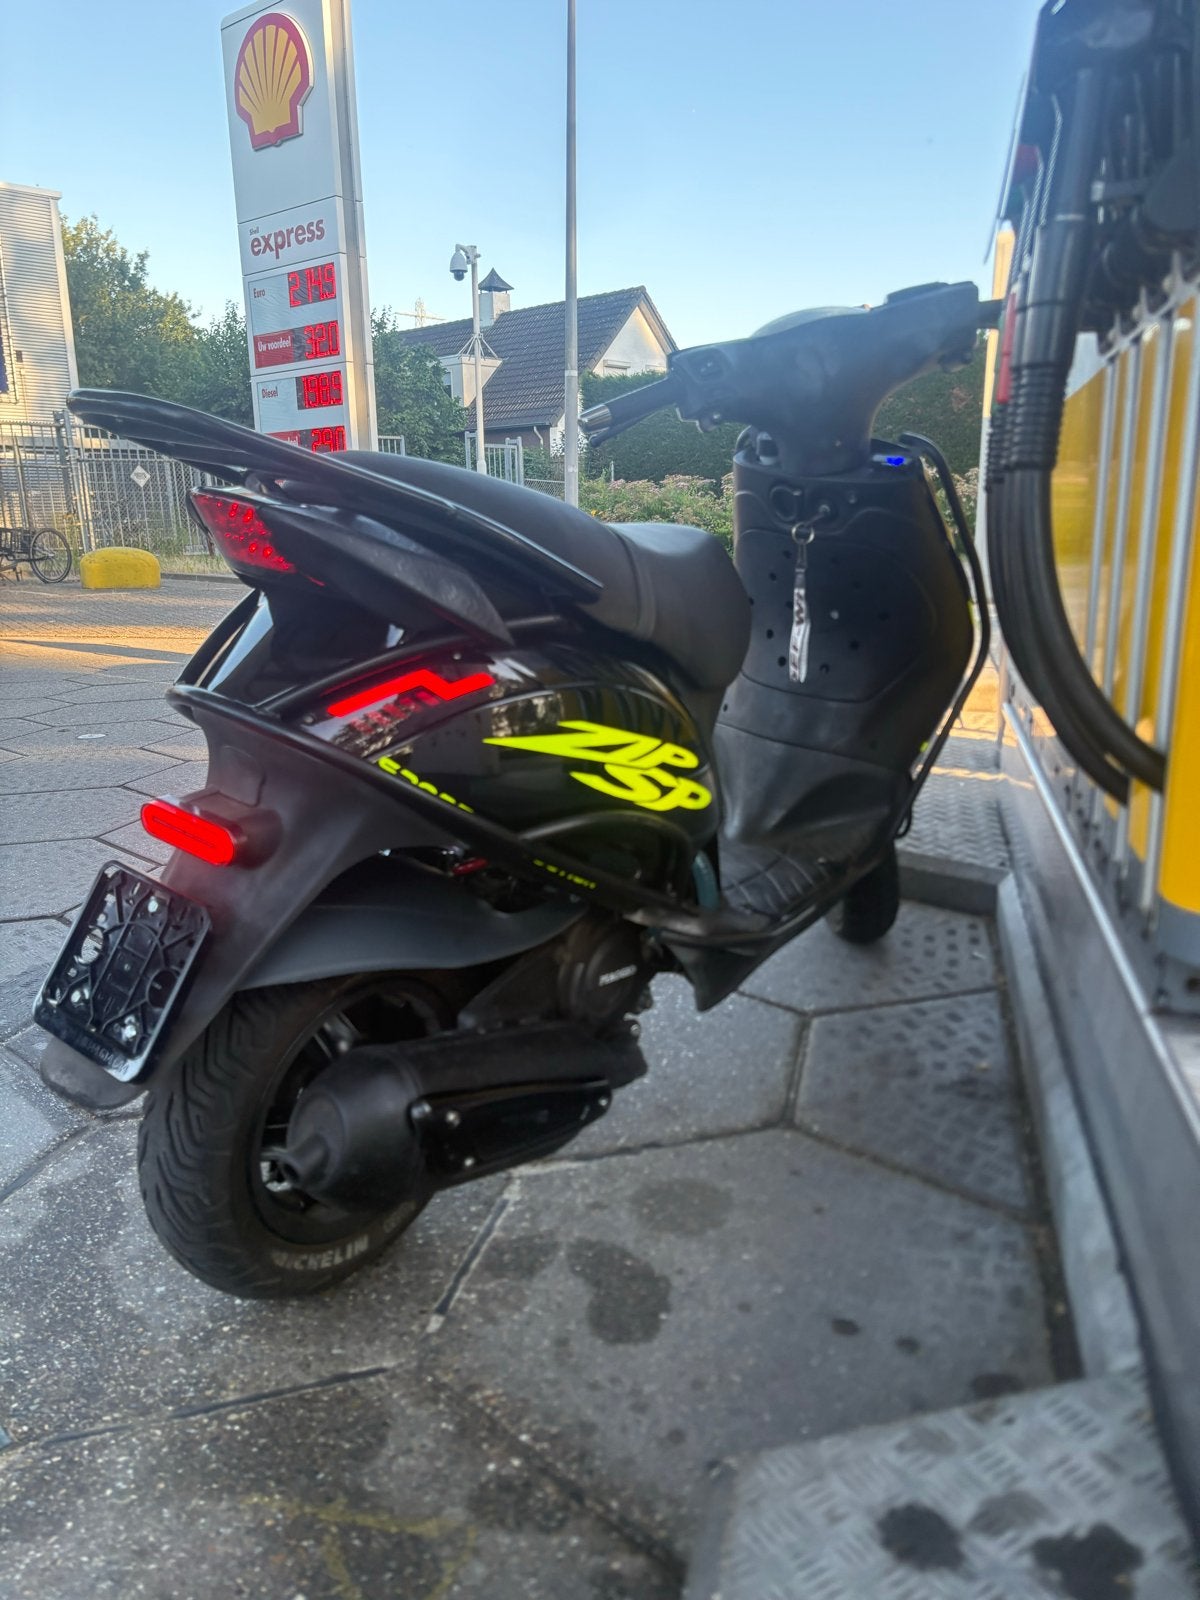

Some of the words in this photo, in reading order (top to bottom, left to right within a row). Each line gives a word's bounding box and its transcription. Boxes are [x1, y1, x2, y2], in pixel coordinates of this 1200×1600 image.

[250, 219, 325, 259] express
[253, 288, 266, 299] Euro
[257, 341, 267, 352] Uw
[267, 336, 292, 351] voordeel
[262, 386, 279, 399] Diesel
[482, 720, 699, 769] ZIP
[569, 763, 713, 811] SP
